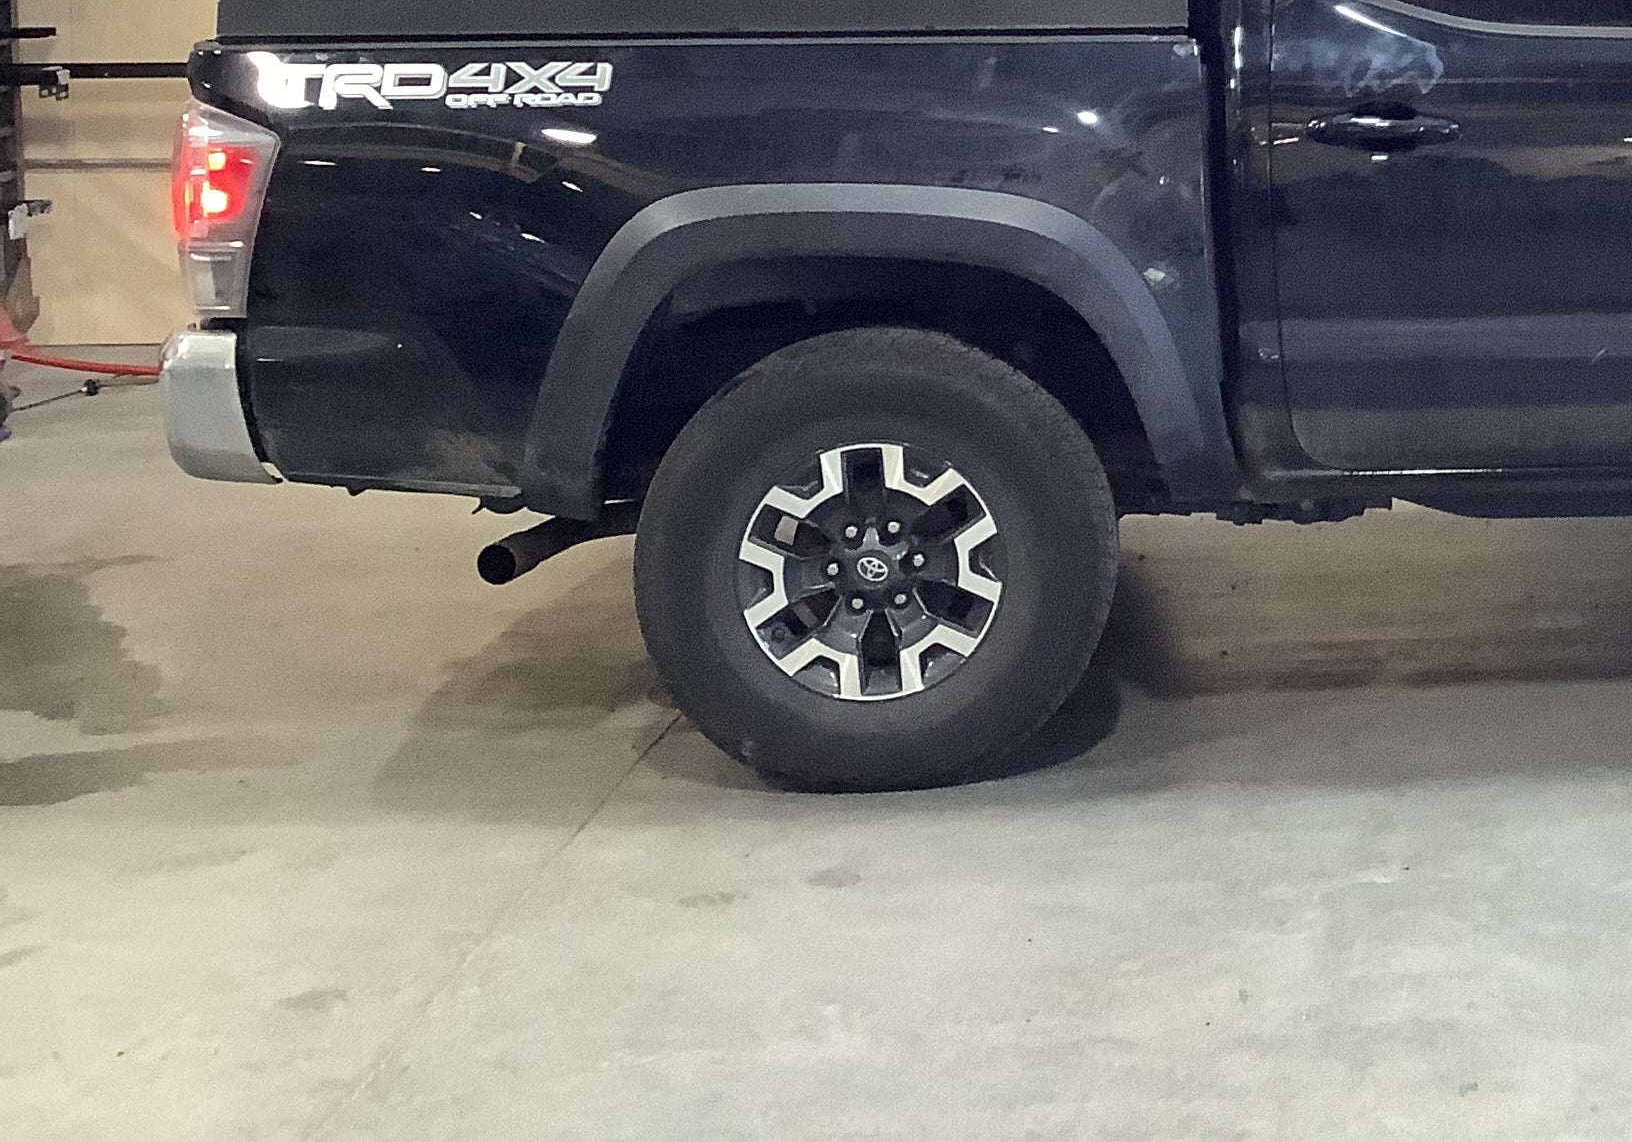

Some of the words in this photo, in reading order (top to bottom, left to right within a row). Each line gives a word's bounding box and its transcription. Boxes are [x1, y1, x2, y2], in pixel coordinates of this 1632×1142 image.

[270, 63, 447, 110] TRD
[445, 92, 511, 108] OFF
[513, 91, 602, 108] ROAD
